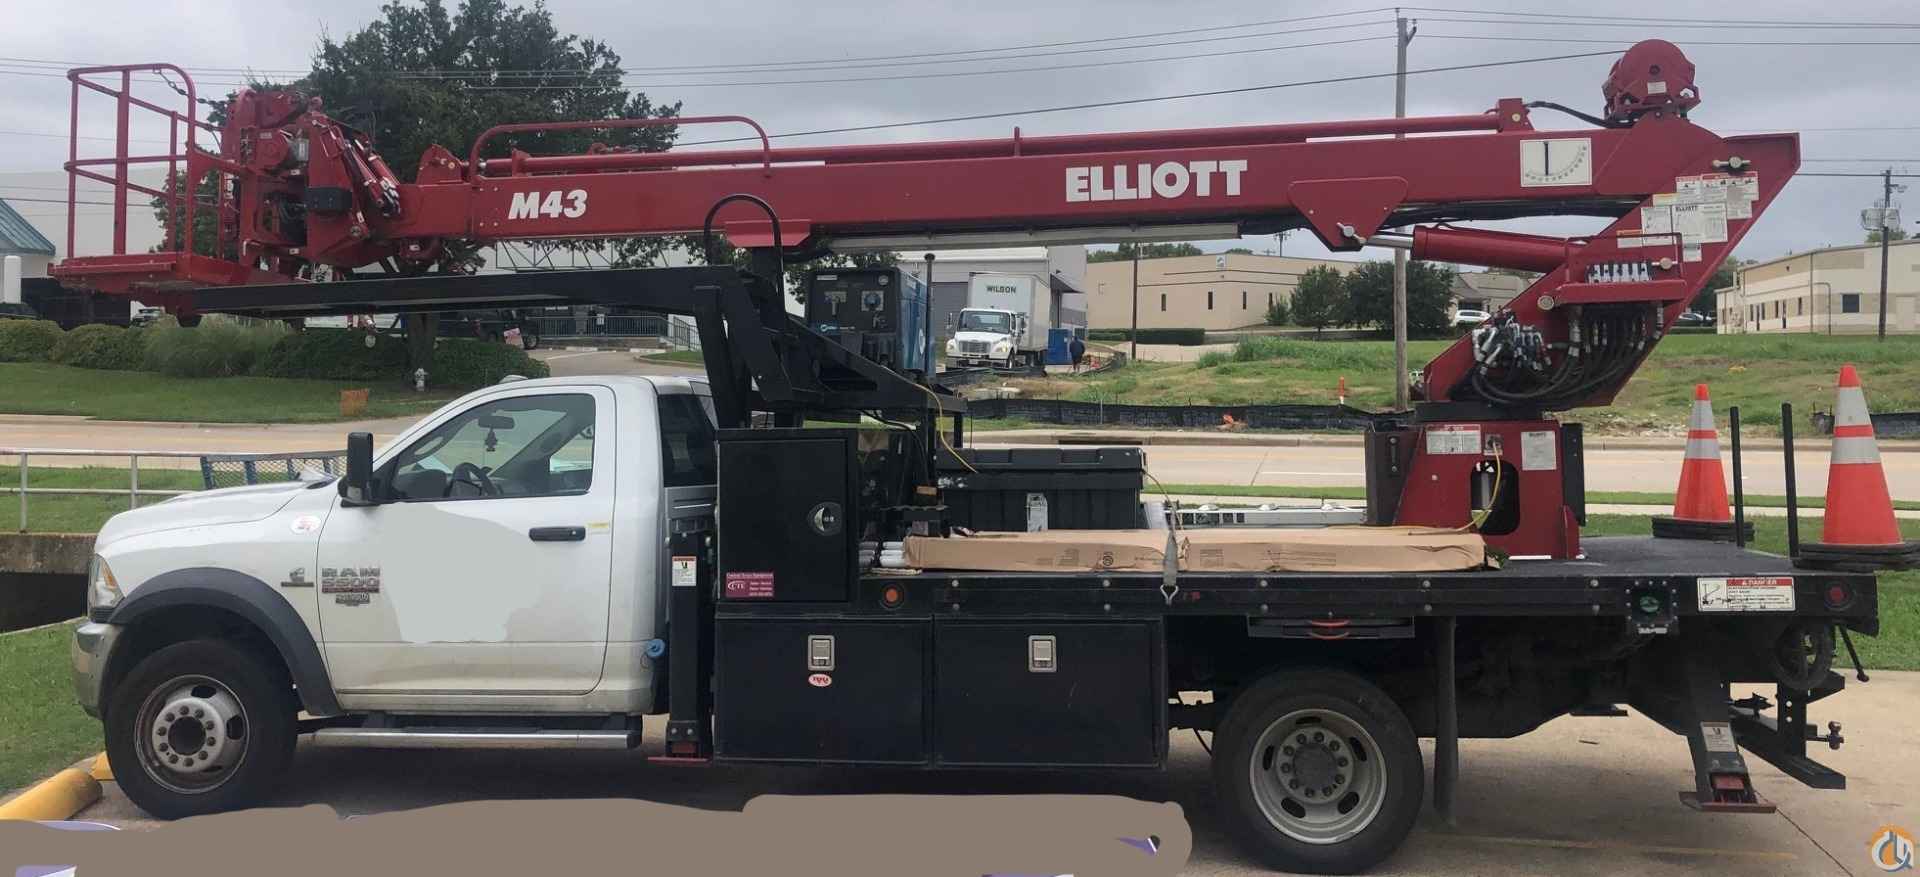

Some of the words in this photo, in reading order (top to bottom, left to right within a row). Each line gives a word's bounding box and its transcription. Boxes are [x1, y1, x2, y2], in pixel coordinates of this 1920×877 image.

[1066, 160, 1248, 202] ELLIOTT
[508, 189, 588, 220] M43
[321, 568, 380, 577] RAM
